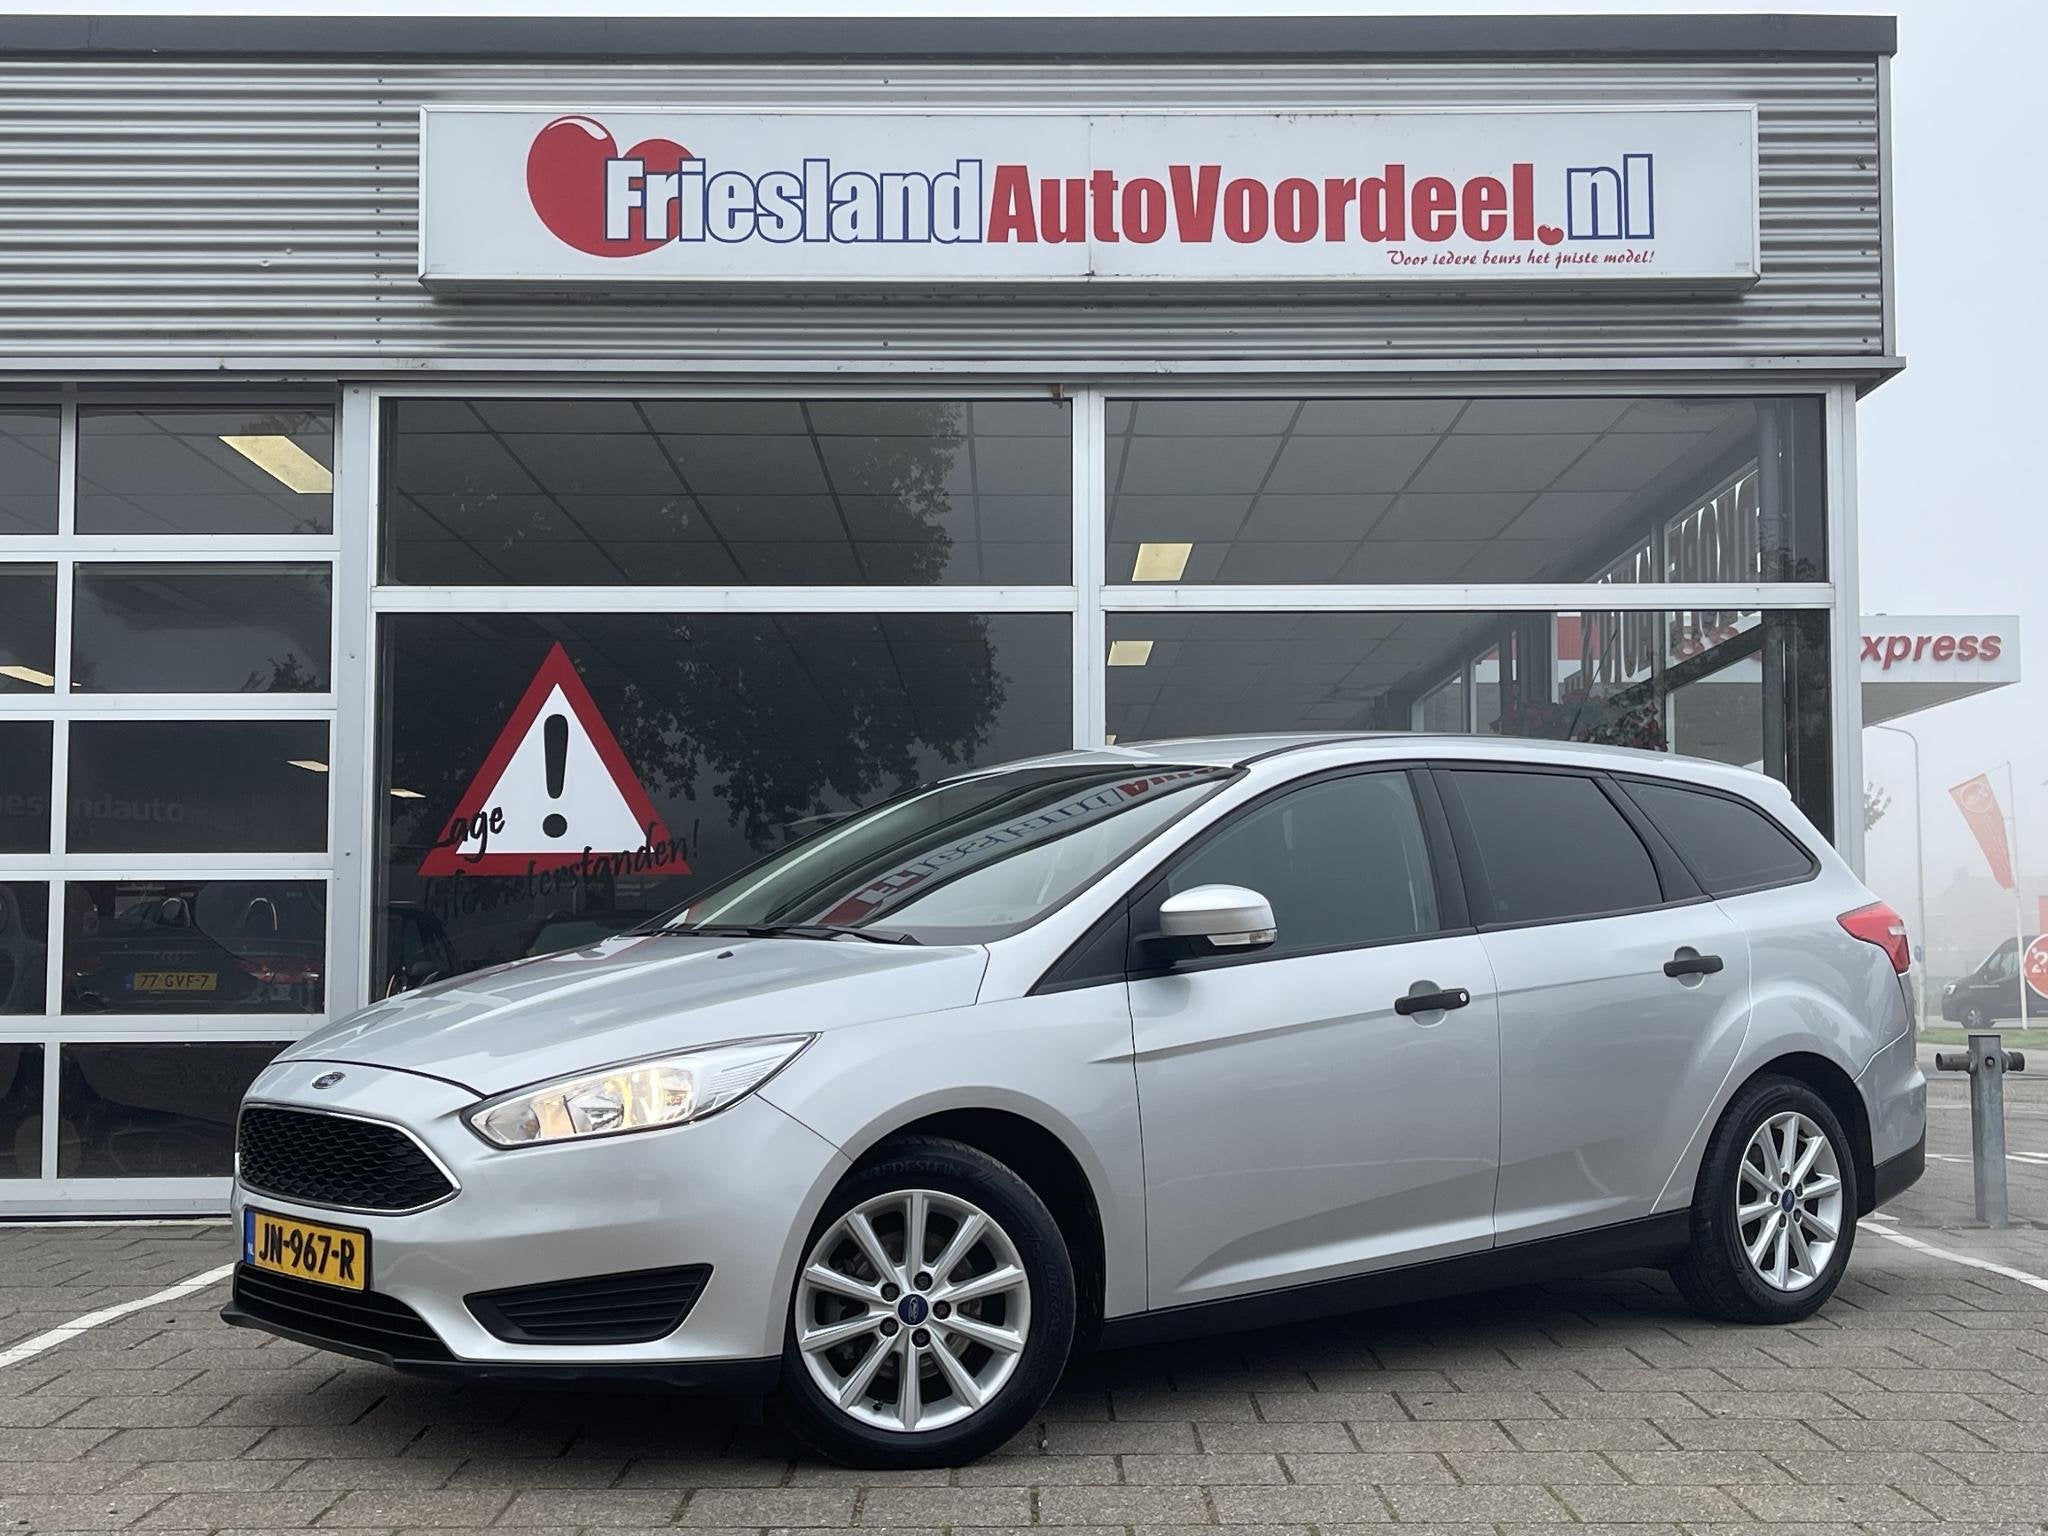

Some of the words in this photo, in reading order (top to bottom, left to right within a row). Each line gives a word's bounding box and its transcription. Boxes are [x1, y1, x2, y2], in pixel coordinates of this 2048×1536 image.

[1386, 250, 1428, 266] Voor
[1432, 250, 1477, 265] iedere
[1482, 249, 1521, 265] beurs
[1527, 248, 1550, 264] het
[1555, 251, 1599, 269] juiste
[1603, 248, 1655, 264] model!
[259, 1222, 355, 1281] JN-967-R
